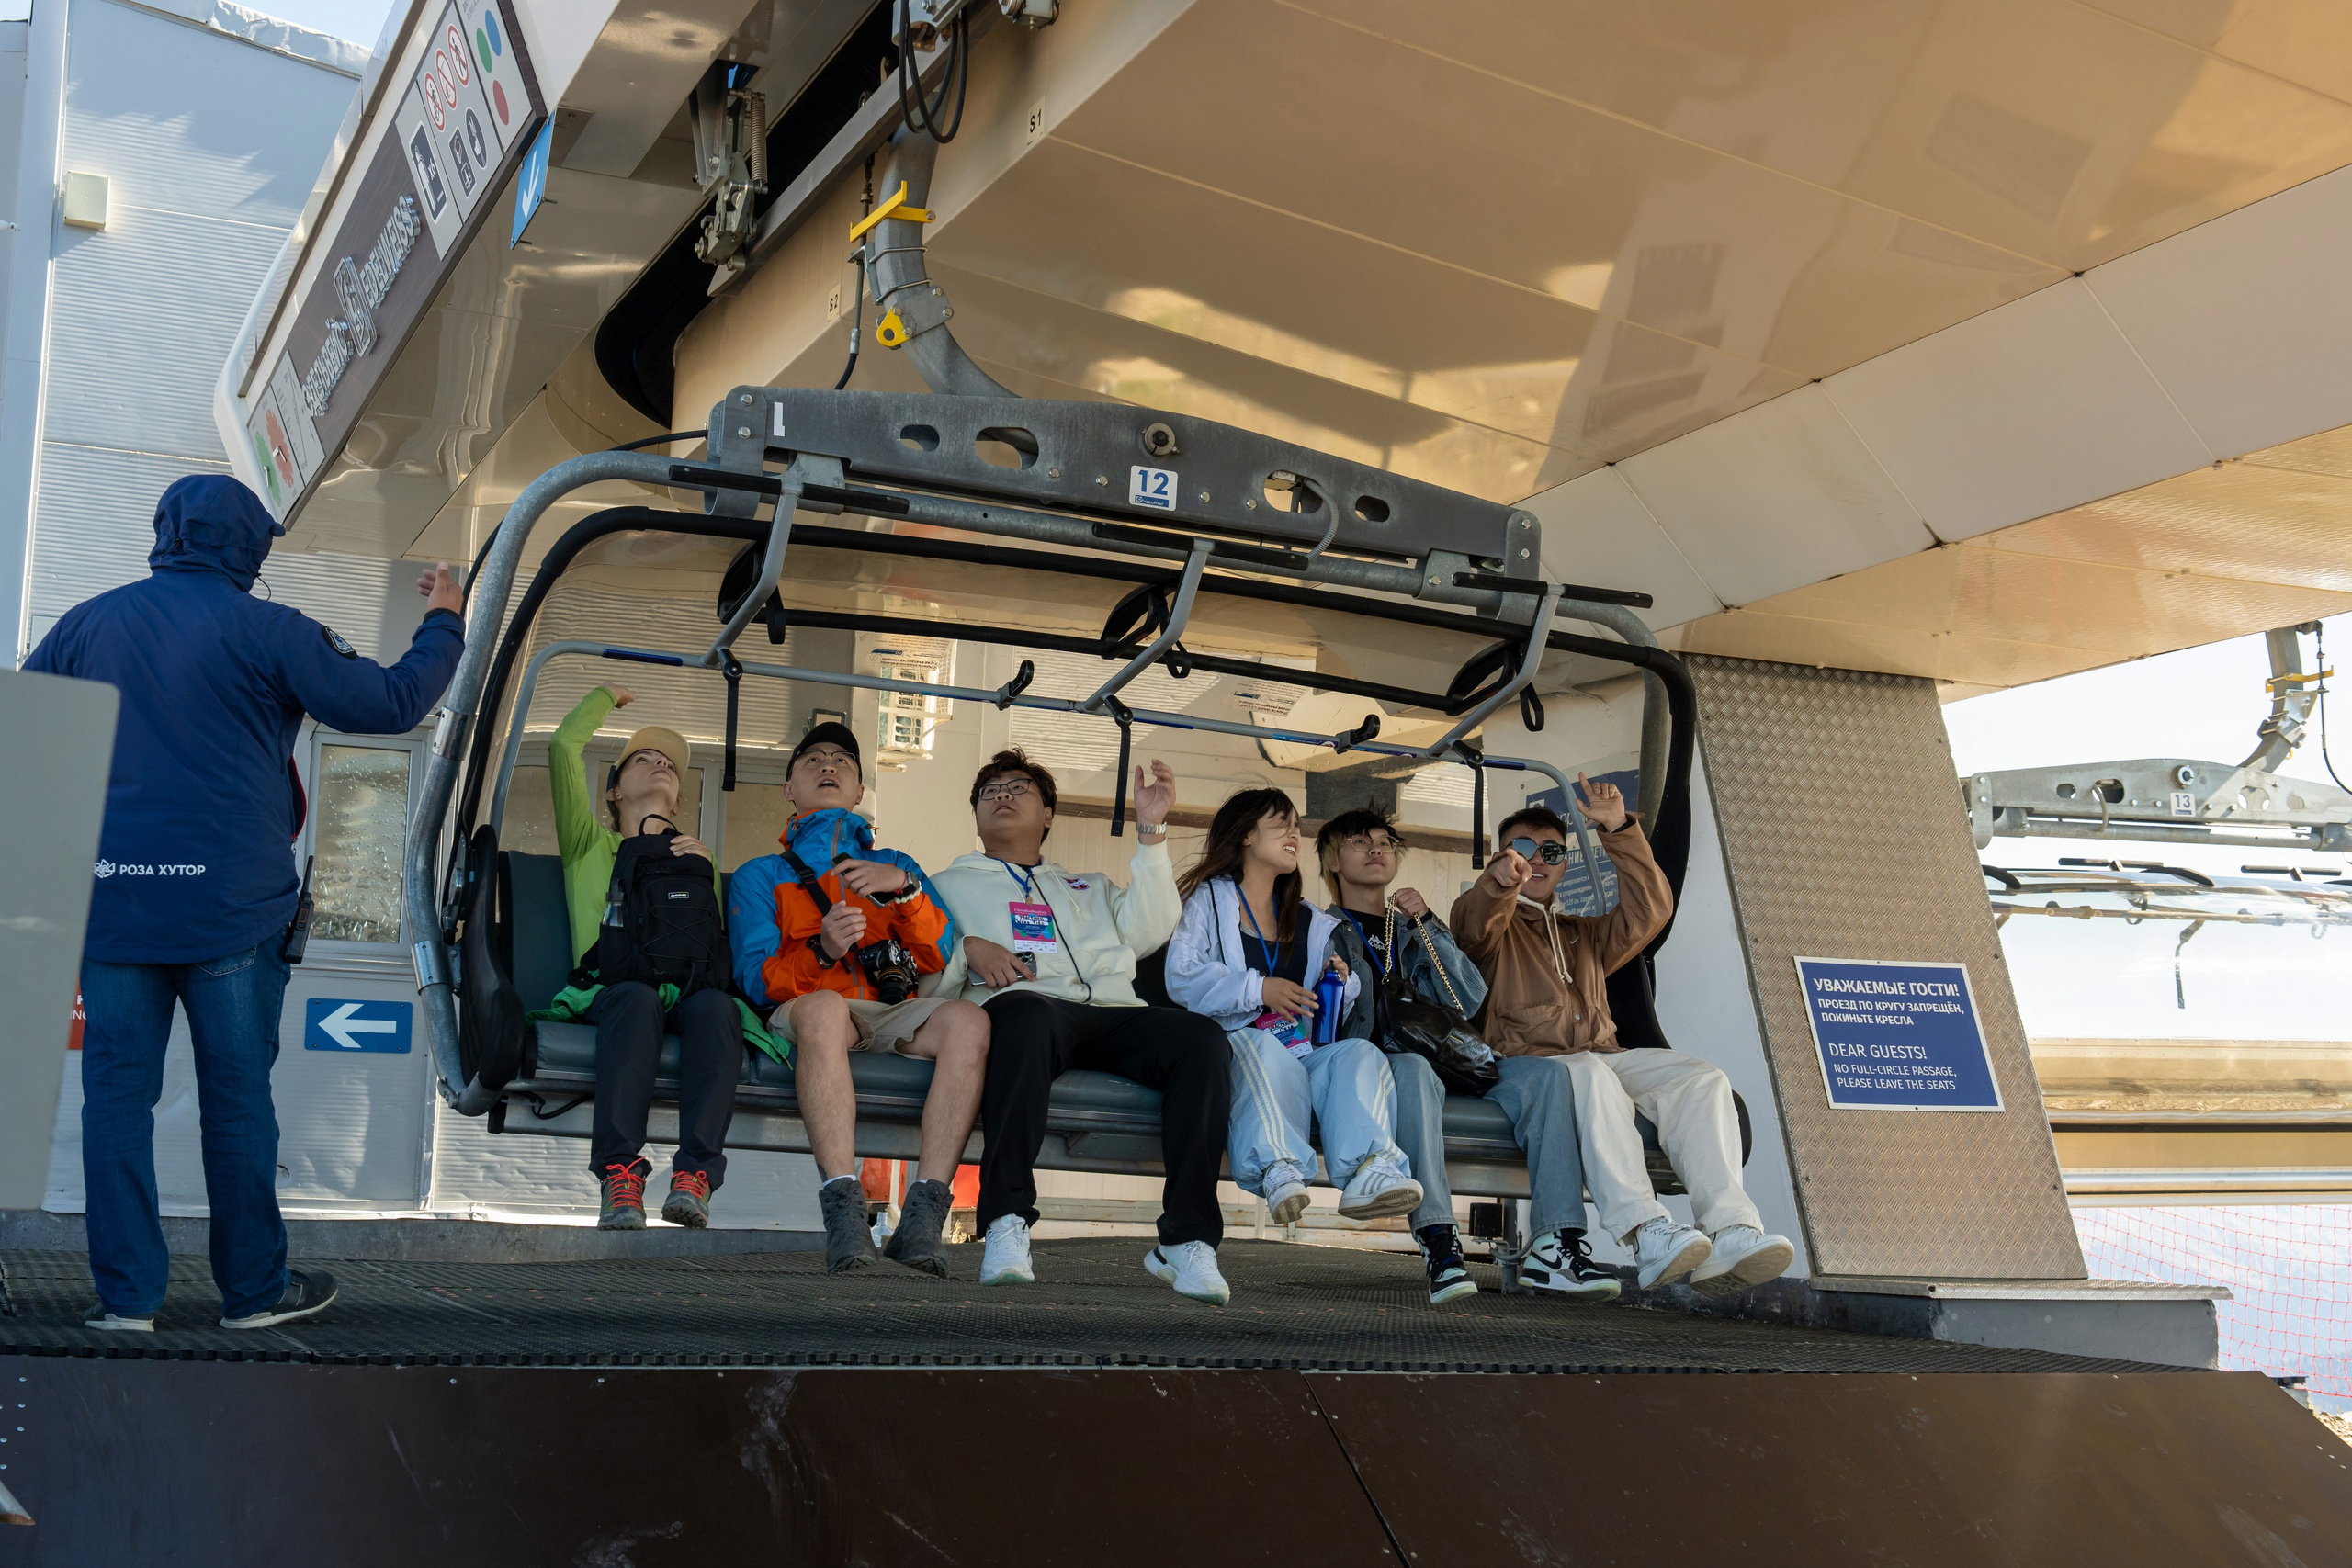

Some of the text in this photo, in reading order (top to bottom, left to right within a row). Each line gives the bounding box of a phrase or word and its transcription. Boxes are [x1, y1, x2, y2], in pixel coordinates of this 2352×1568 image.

[359, 195, 421, 310] EDELWEISS
[302, 317, 355, 418] ЭДЕЛЬВЕЙС
[1137, 469, 1170, 496] 12
[2174, 794, 2191, 808] 13
[119, 863, 207, 876] РОЗА ХУТОР
[1813, 977, 1960, 997] УВАЖАЕМЫЕ ГОСТИ!
[1817, 998, 1964, 1015] ПРОЕЗД ПО КРУГУ ЗАПРЕЩЁН,
[1821, 1012, 1914, 1026] ПОКИНЬТЕ КРЕСЛА
[1828, 1043, 1927, 1059] DEAR GUESTS!
[1833, 1064, 1957, 1077] NO FULL-CIRCLE PASSAGE,
[1838, 1077, 1956, 1090] PLEASE LEAVE THE SEATS
